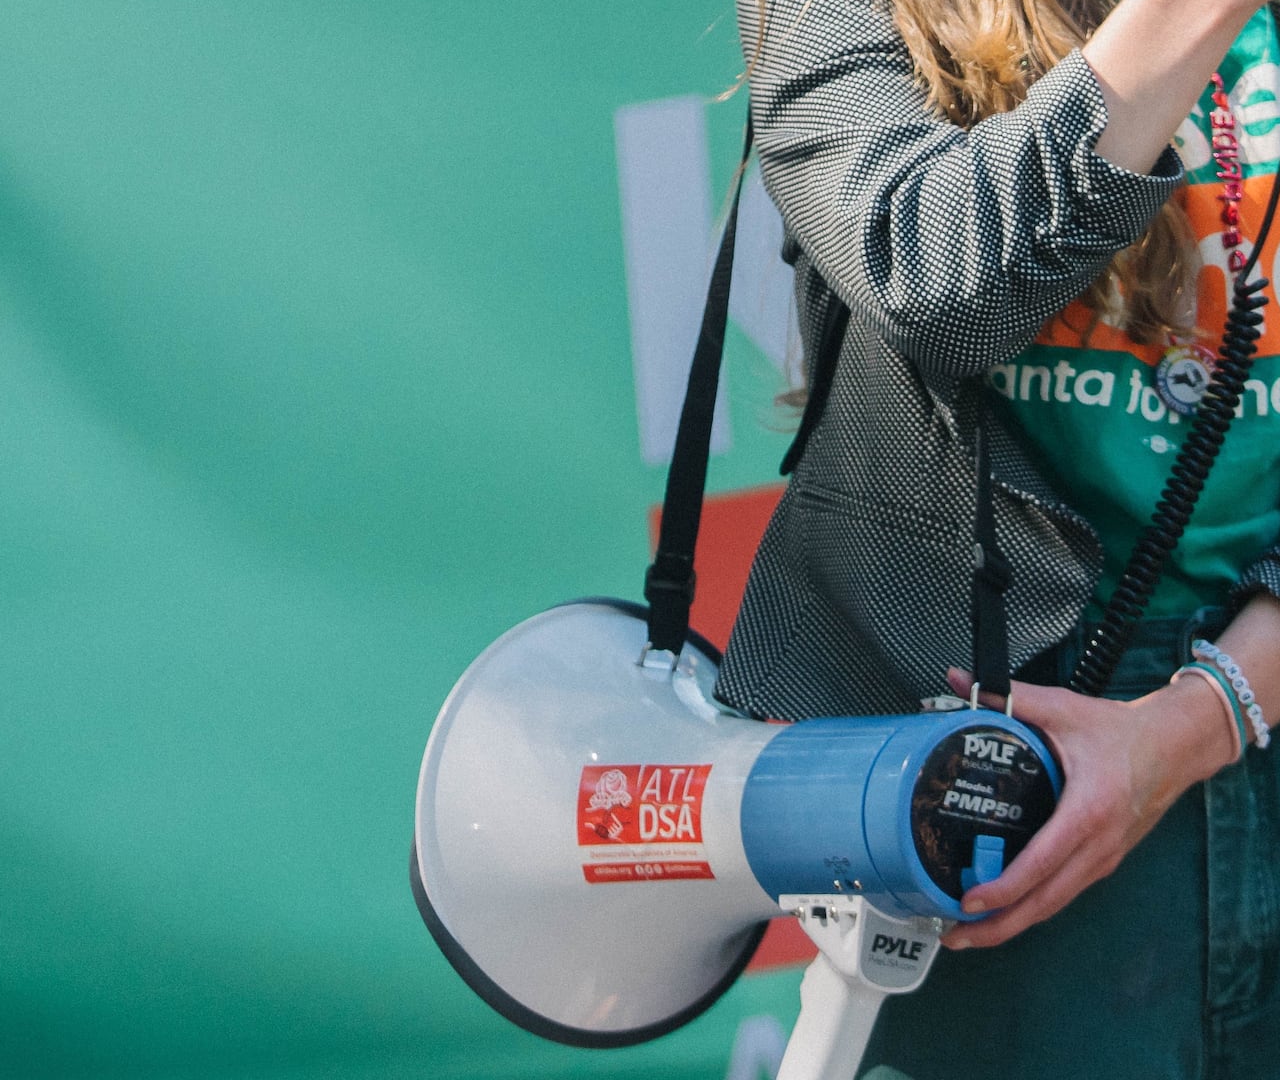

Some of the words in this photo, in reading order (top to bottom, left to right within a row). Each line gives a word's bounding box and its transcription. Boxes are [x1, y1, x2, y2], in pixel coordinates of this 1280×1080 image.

[640, 768, 697, 803] ATL
[954, 778, 994, 795] Model:
[943, 790, 1022, 820] PMP50
[638, 803, 696, 840] DSA
